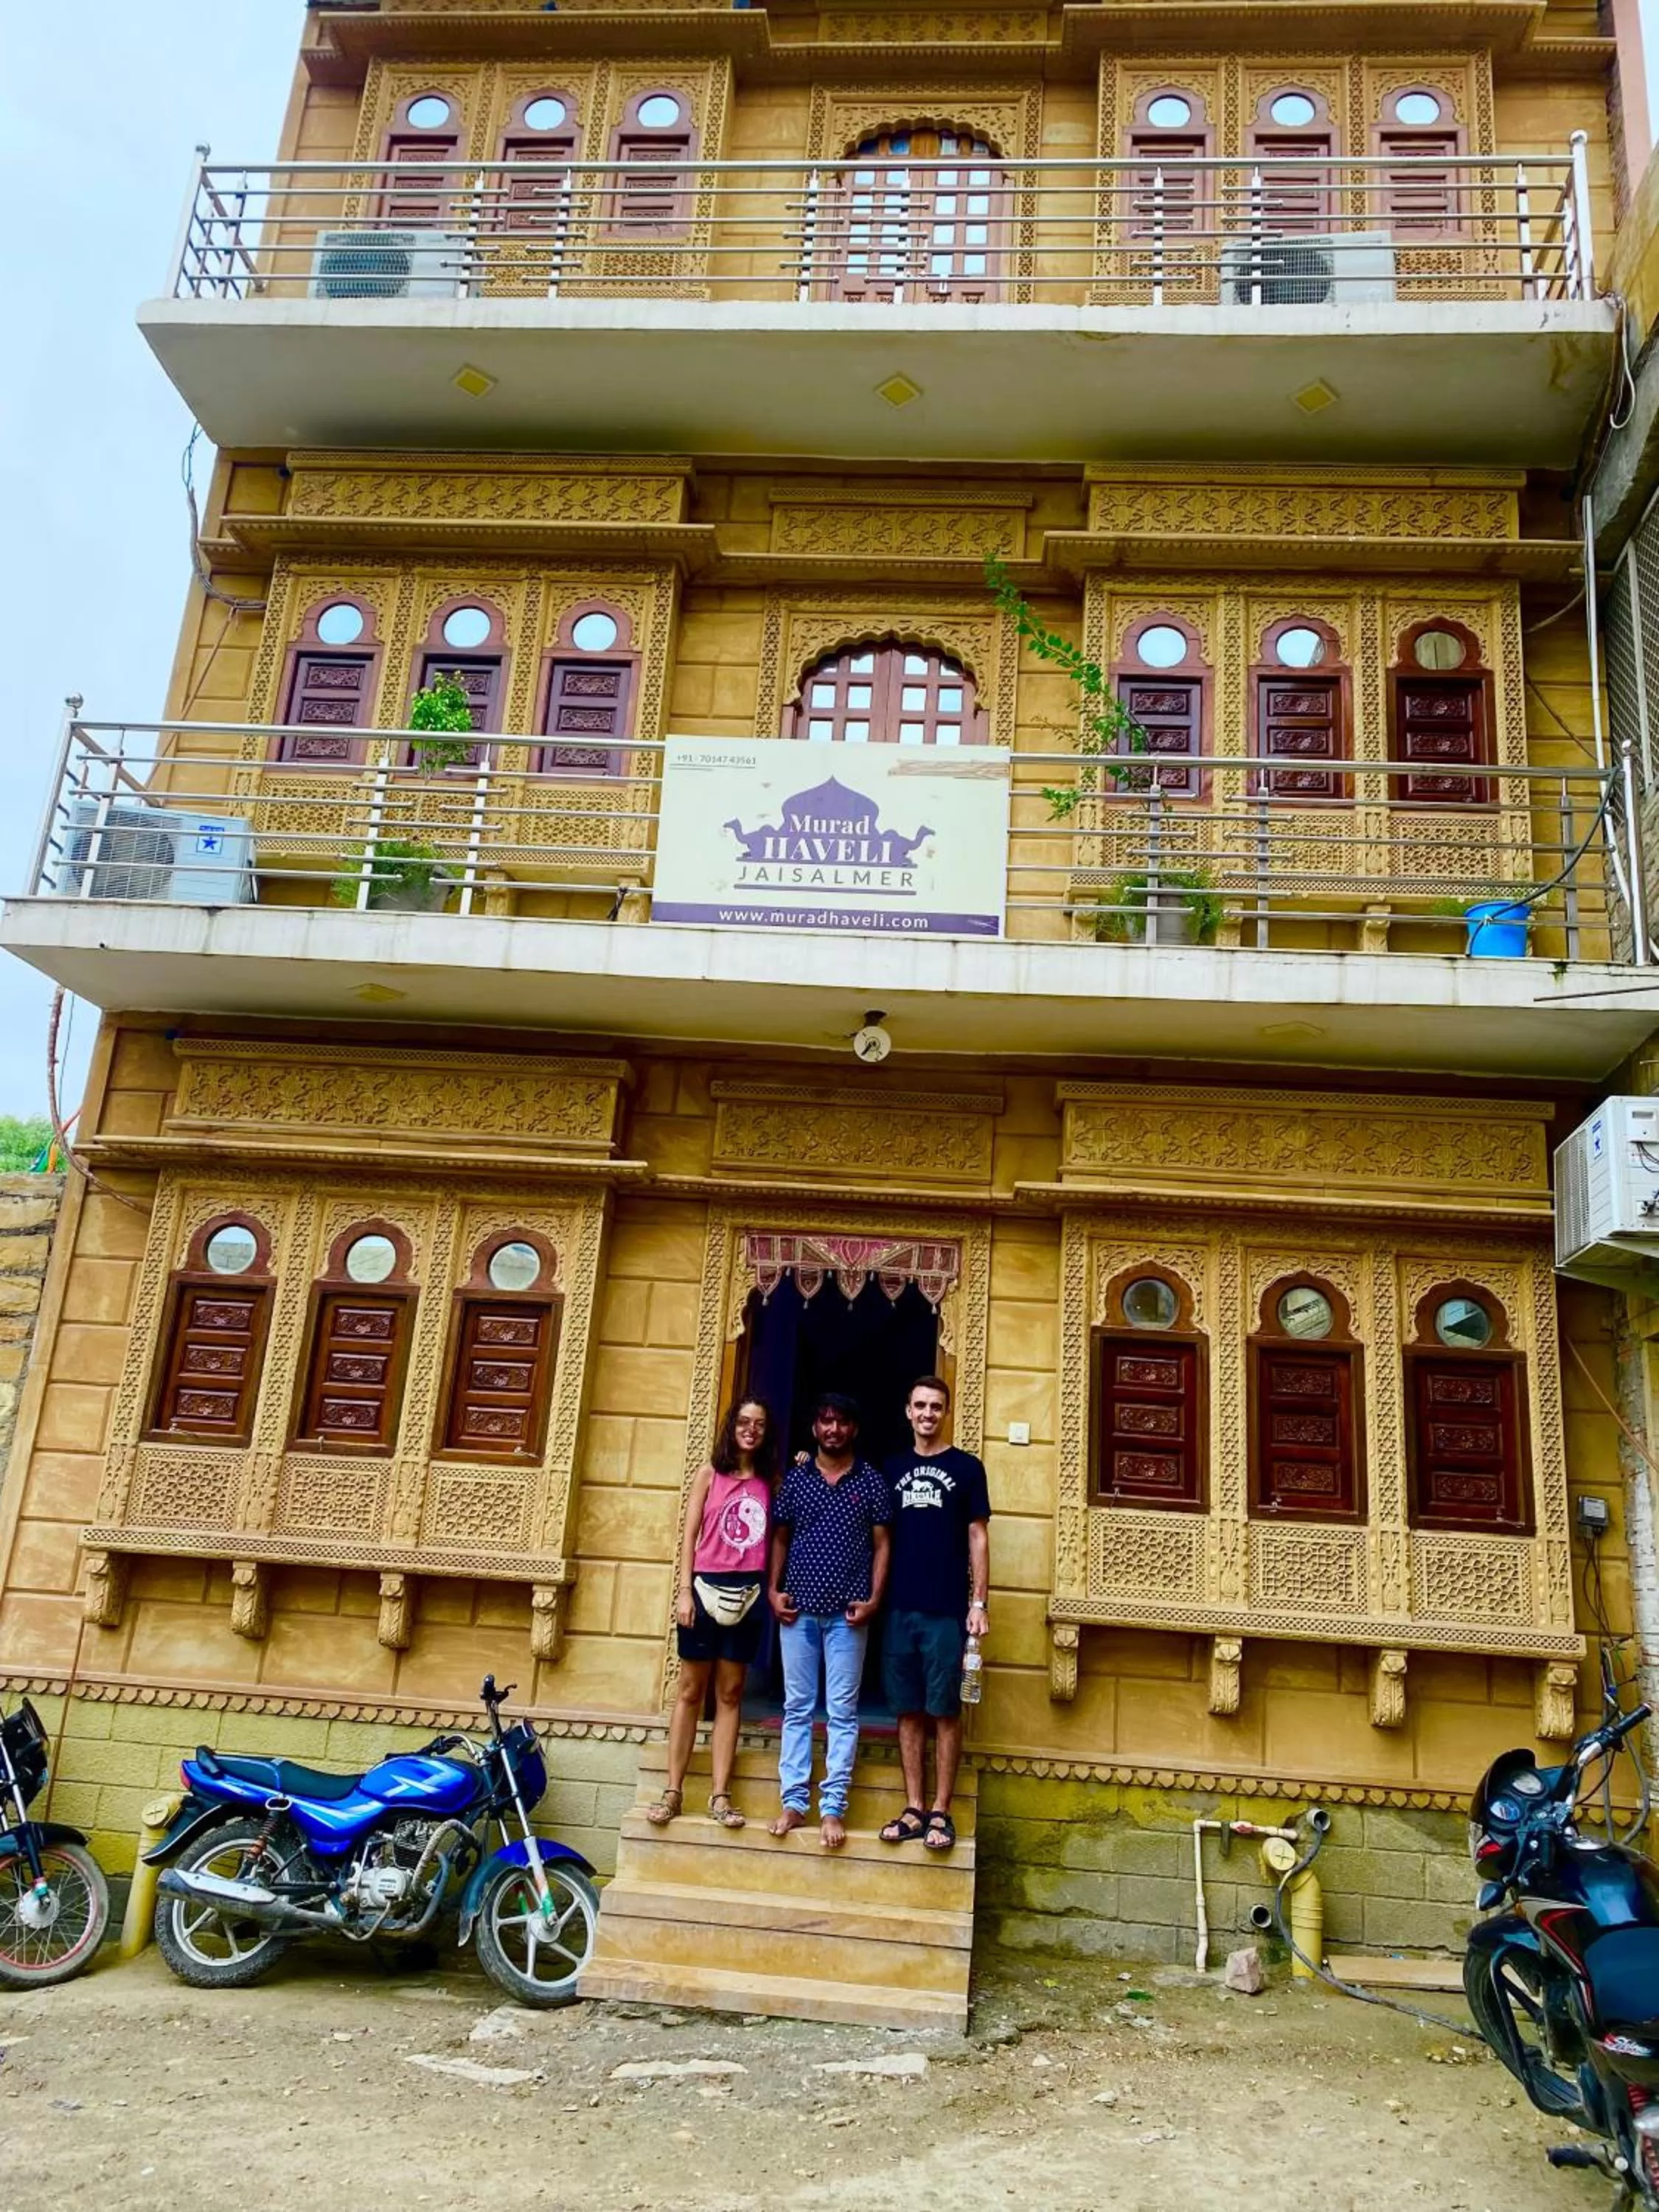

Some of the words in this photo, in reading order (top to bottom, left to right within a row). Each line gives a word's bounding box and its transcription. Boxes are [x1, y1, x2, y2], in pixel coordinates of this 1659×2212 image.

[789, 813, 870, 835] Murad
[762, 837, 892, 863] HAVELI
[738, 866, 914, 887] JAISALMER
[718, 910, 929, 928] www.muradhaveli.com
[894, 1471, 912, 1492] THE
[914, 1465, 956, 1492] ORIGINAL
